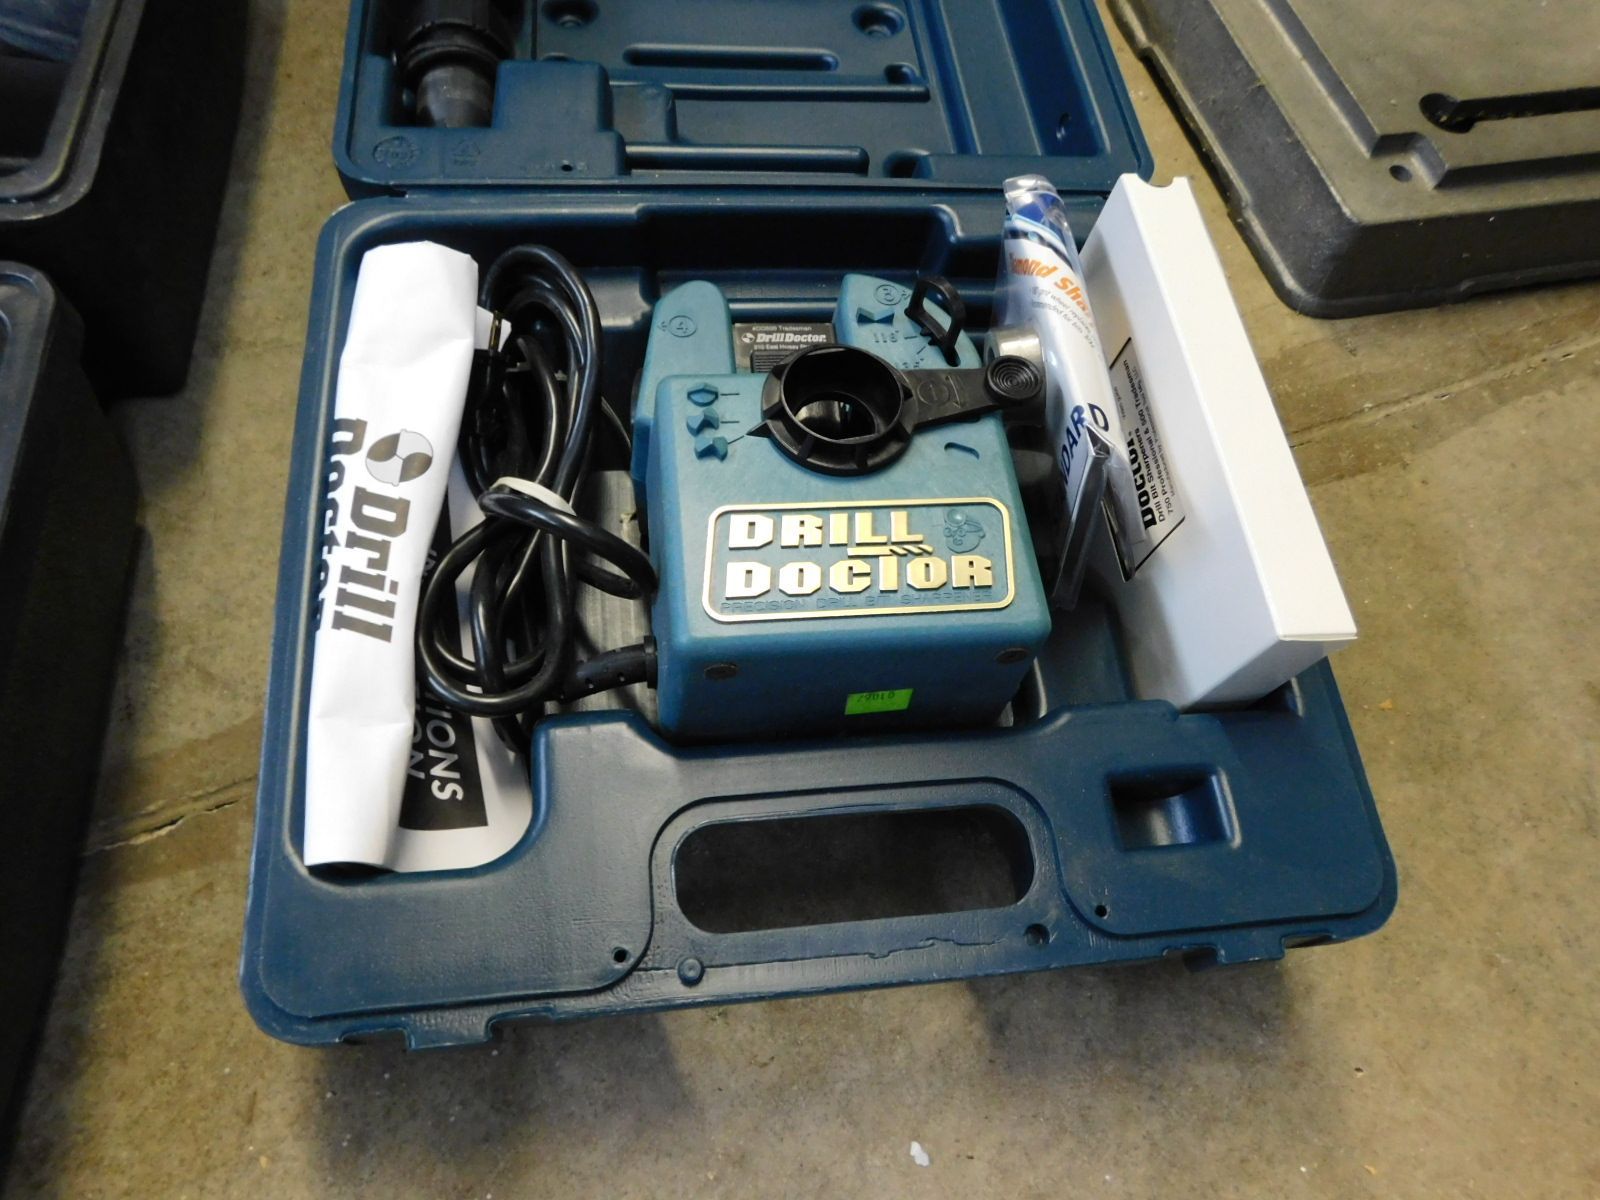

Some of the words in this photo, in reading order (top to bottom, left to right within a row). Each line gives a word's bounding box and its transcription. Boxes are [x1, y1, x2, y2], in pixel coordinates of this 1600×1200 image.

[1123, 359, 1141, 410] Tradesman
[1137, 408, 1147, 427] 500
[1144, 427, 1150, 435] &
[1134, 427, 1154, 484] Sharpeners
[1147, 436, 1168, 496] Professional
[1150, 483, 1159, 500] Bit
[1164, 497, 1174, 515] 750
[1154, 501, 1166, 523] Drill
[728, 510, 924, 549] DRILL
[332, 485, 411, 644] Drill
[725, 554, 994, 600] DOCTOR
[720, 599, 806, 614] PRECISION
